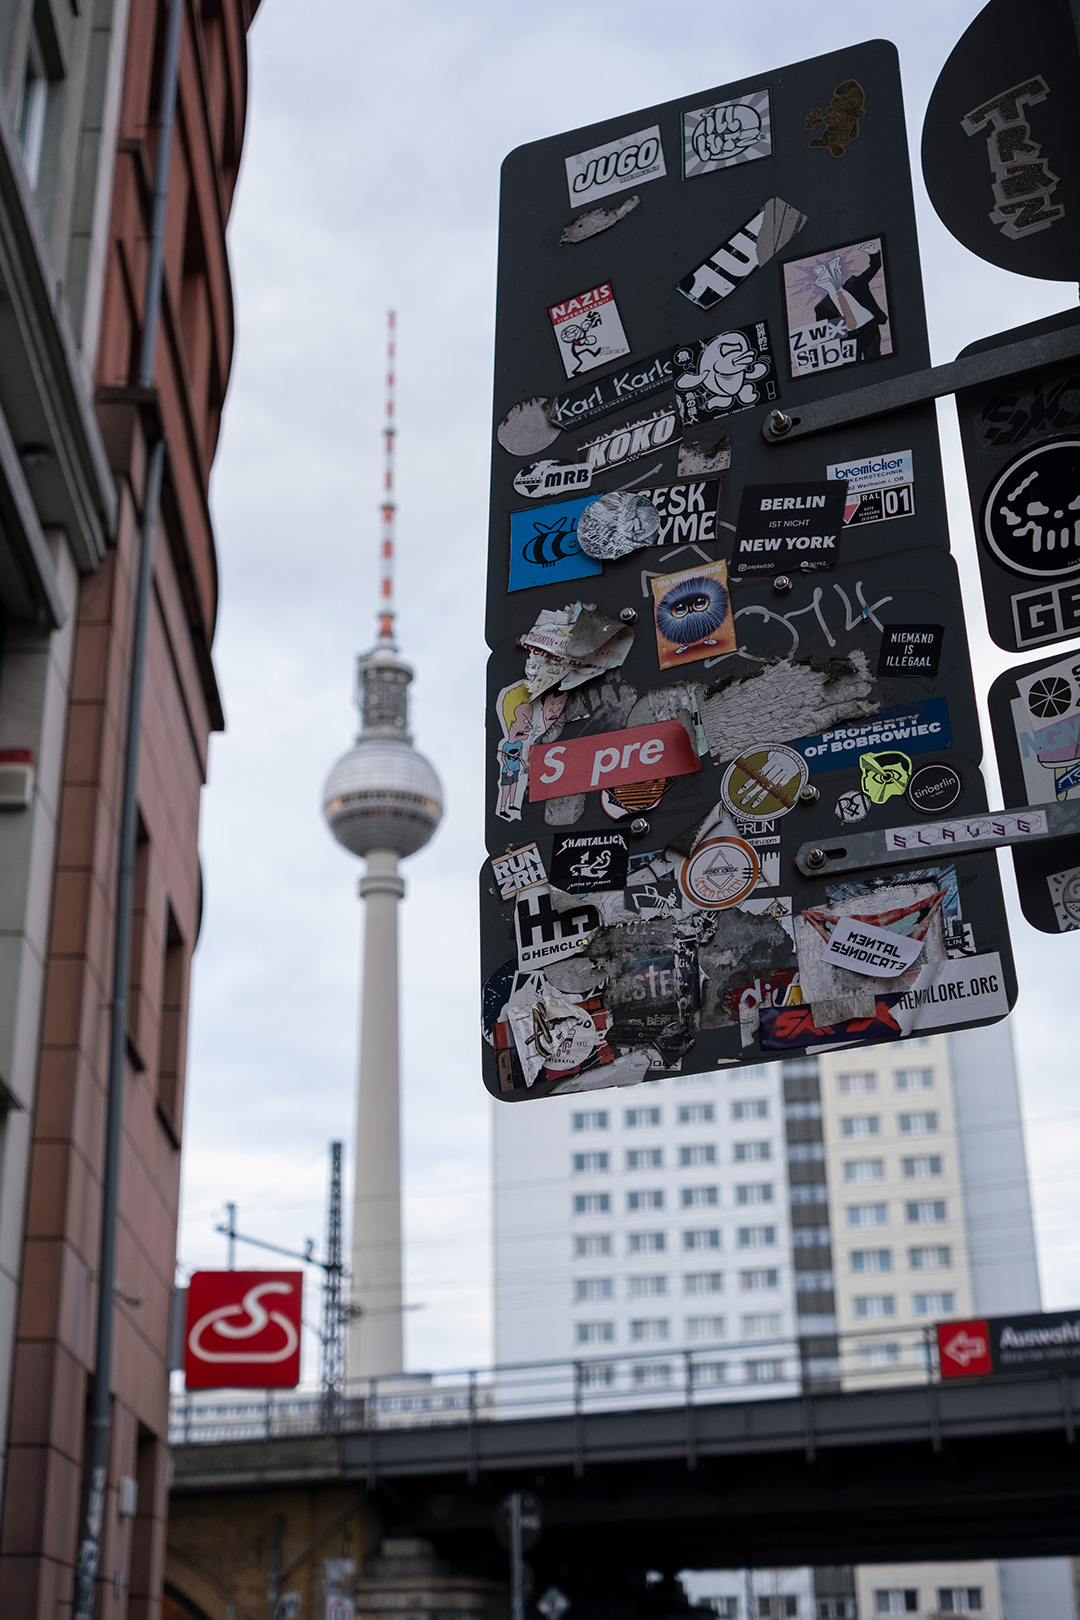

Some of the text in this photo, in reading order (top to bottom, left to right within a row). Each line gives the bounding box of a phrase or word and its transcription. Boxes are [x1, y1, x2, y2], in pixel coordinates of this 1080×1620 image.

[573, 138, 660, 193] JUGO
[551, 285, 610, 319] NAZIS
[554, 386, 603, 421] Karl
[563, 415, 582, 427] IMPLE
[590, 394, 633, 416] SUSTAINABLE
[587, 414, 677, 469] KOKO
[544, 469, 589, 488] MRB
[835, 458, 903, 480] bremicker
[857, 480, 887, 489] Weilheim
[760, 495, 826, 511] BERLIN
[862, 492, 880, 501] RAL
[885, 487, 910, 514] 01
[769, 519, 810, 528] IST NICHT
[739, 535, 837, 553] NEW YORK
[747, 562, 775, 570] papke030
[886, 656, 932, 668] ILLEGAAL
[904, 644, 914, 655] IS
[804, 722, 942, 758] OF BOBROWIEC
[822, 713, 920, 743] PROPERTY
[539, 739, 665, 786] S pre
[555, 833, 629, 857] SHANTALLICA
[492, 847, 541, 881] RUN
[499, 862, 548, 897] ZRH
